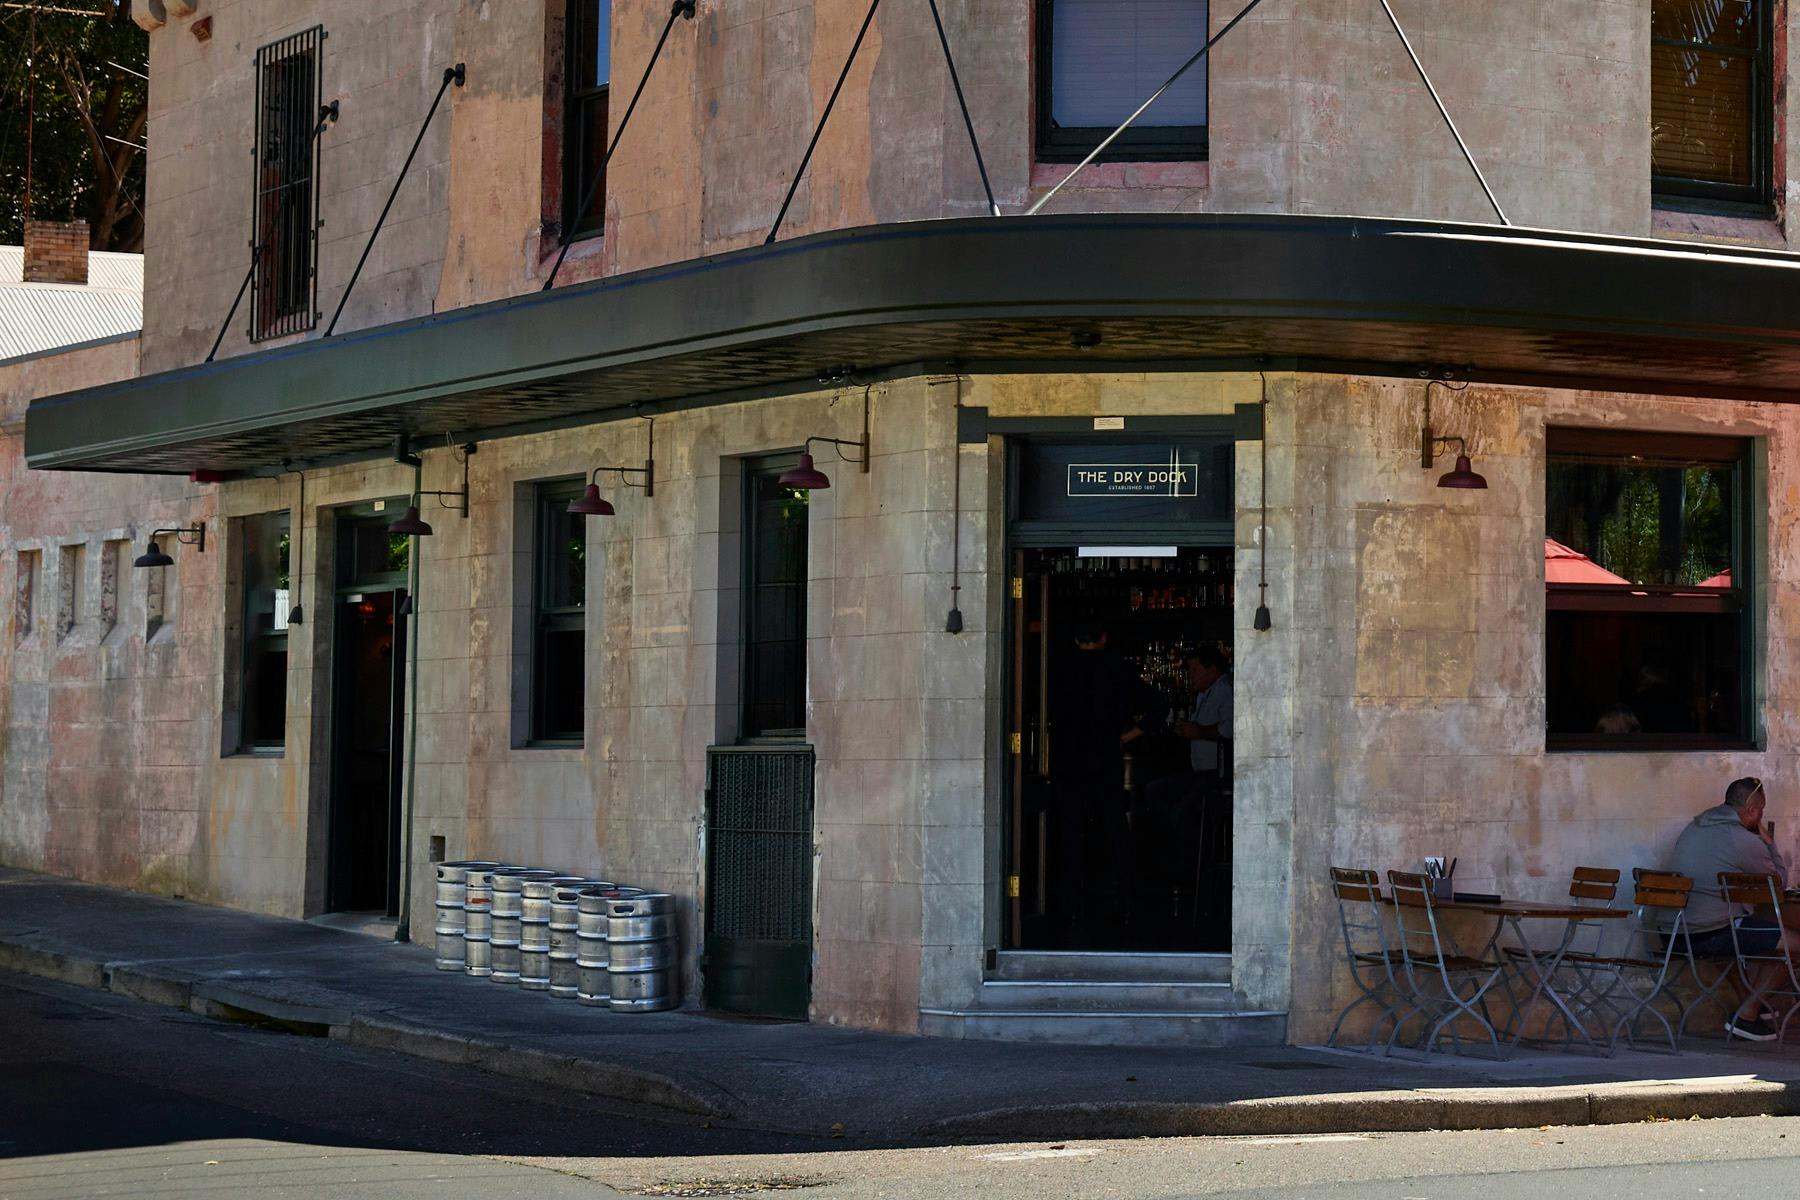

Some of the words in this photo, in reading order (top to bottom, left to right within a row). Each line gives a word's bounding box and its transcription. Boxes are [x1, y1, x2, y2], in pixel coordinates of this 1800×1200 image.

[1077, 471, 1107, 483] THE
[1114, 471, 1143, 483] DRY
[1148, 471, 1187, 483] DOCK
